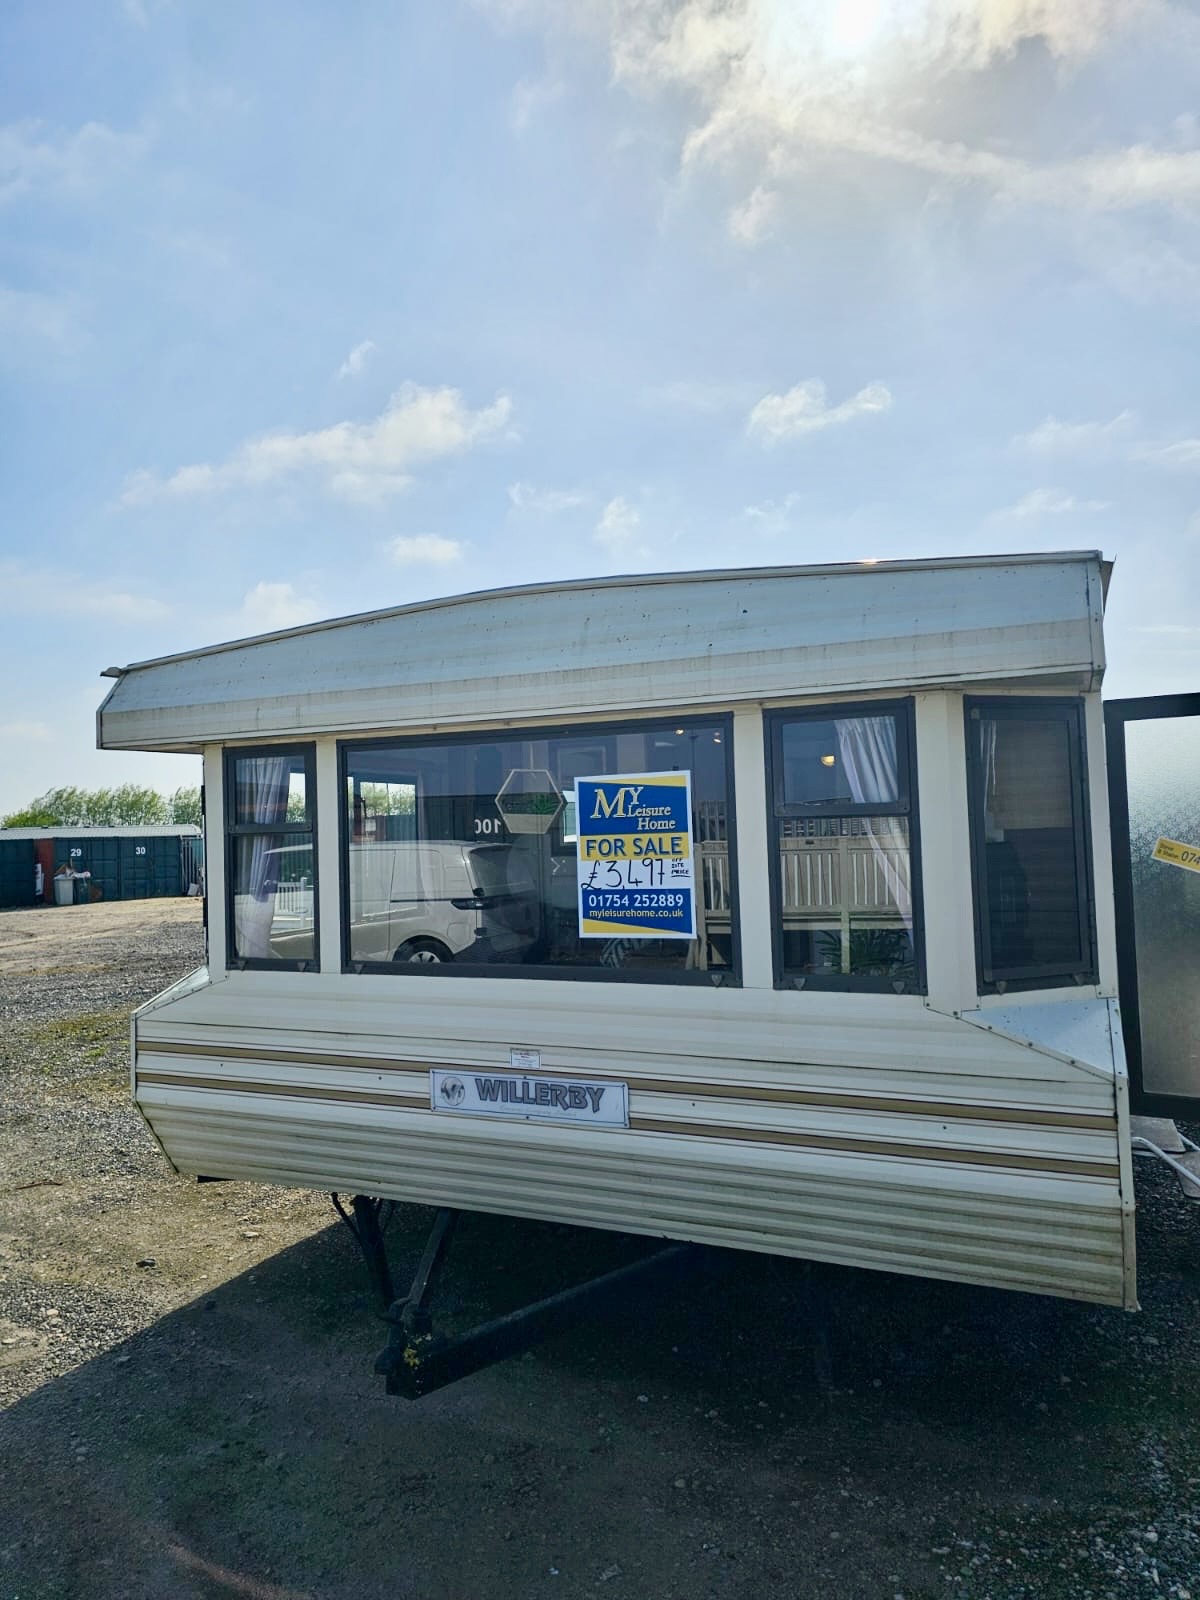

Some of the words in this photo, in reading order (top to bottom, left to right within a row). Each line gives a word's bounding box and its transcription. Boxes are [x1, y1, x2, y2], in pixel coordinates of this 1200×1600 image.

[627, 805, 671, 817] Leisure
[637, 818, 676, 830] Home
[71, 848, 82, 857] 29
[135, 846, 146, 855] 30
[586, 838, 627, 857] FOR
[633, 836, 683, 856] SALE
[581, 857, 665, 890] £3,497
[589, 894, 630, 907] 01754
[633, 894, 683, 907] 252889
[589, 908, 683, 919] myleisurehome.co.uk
[474, 1078, 606, 1113] WILLERBY
